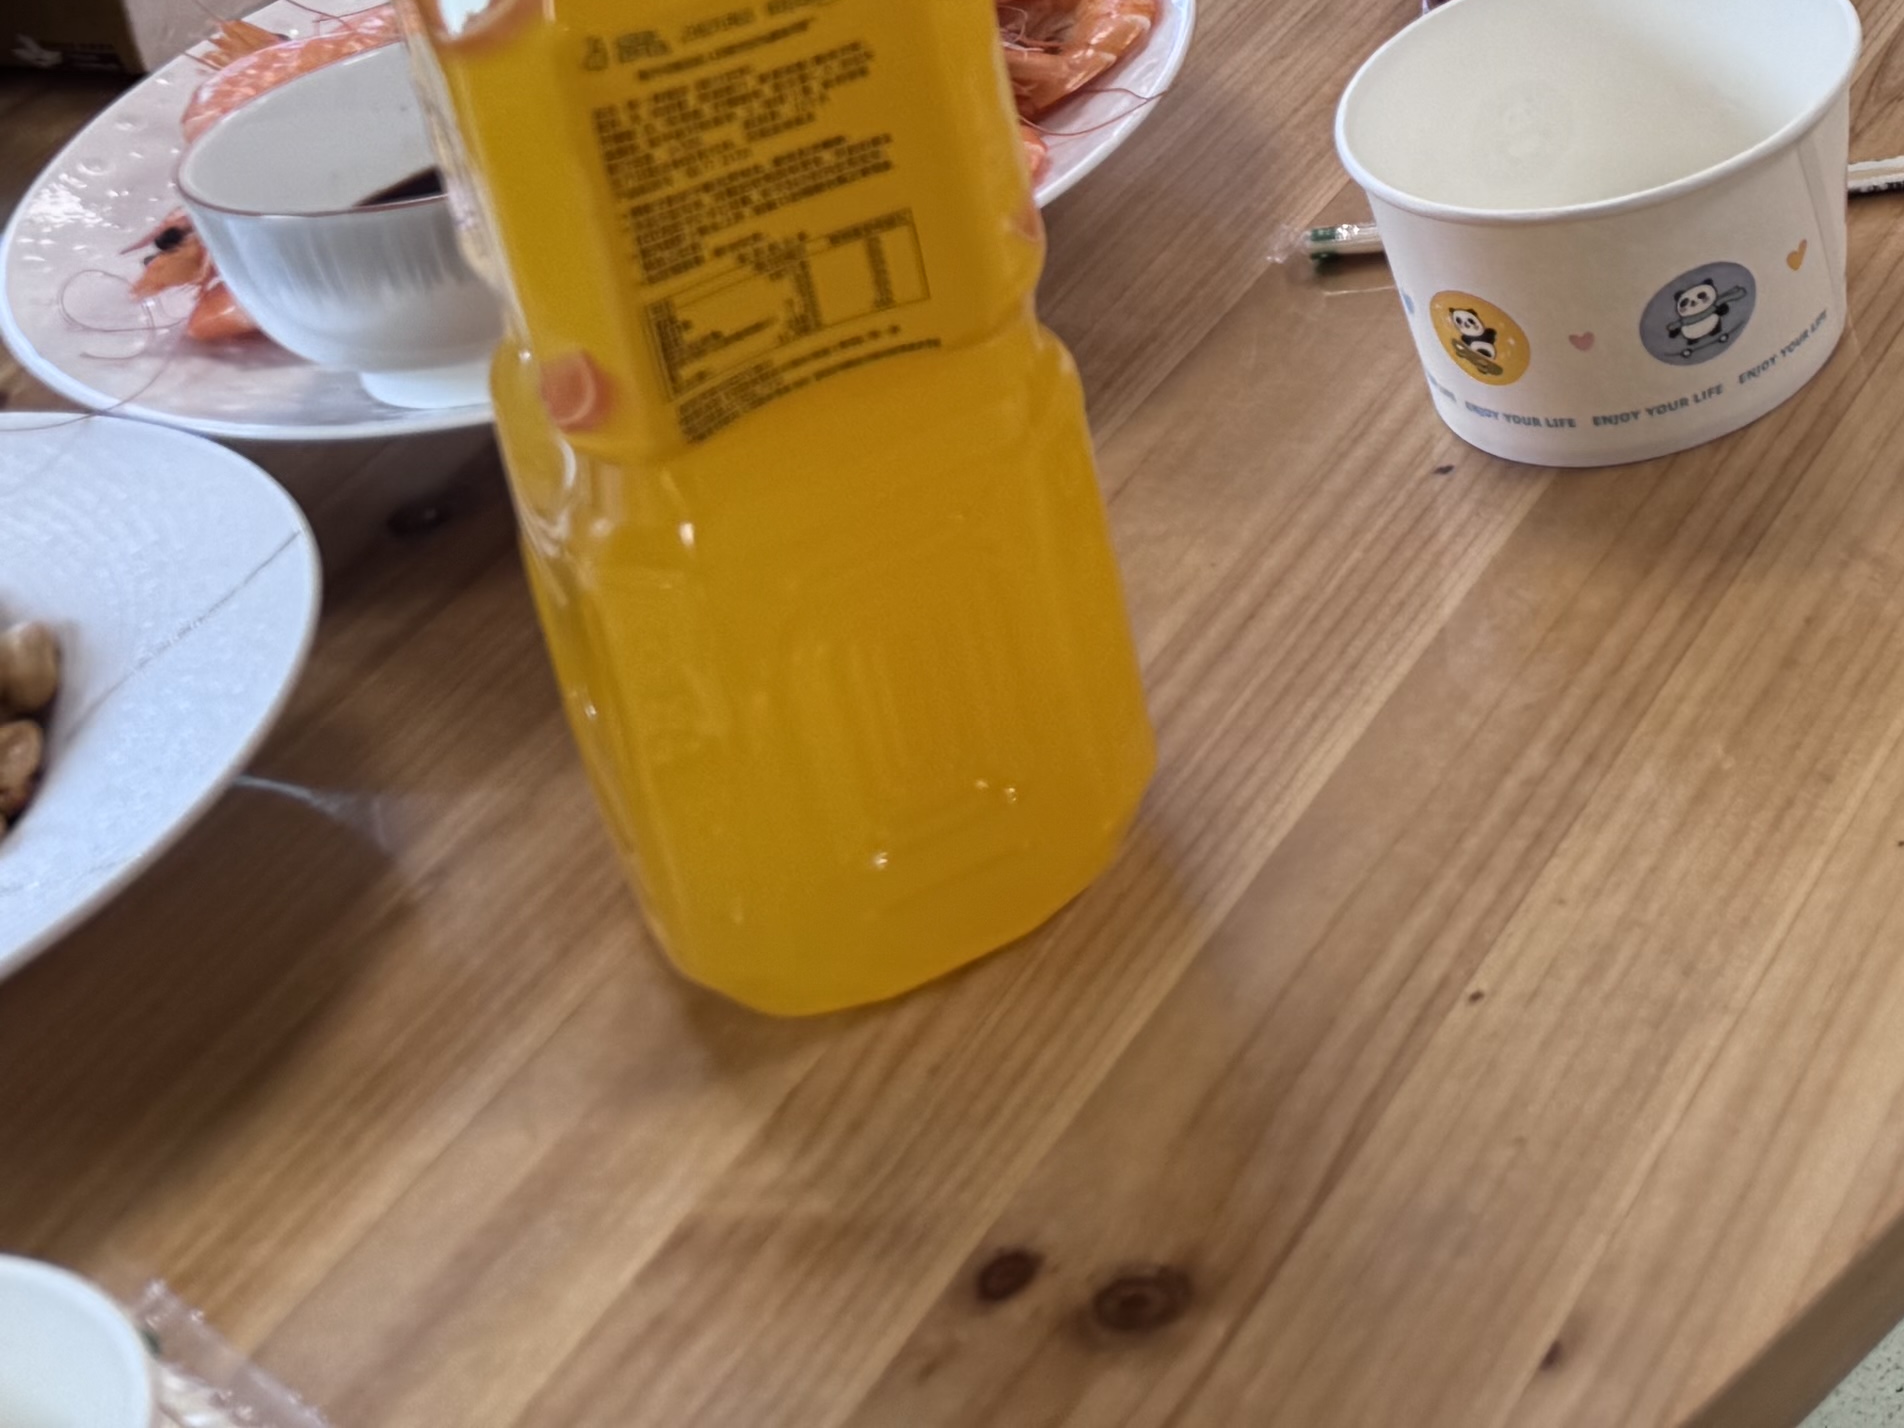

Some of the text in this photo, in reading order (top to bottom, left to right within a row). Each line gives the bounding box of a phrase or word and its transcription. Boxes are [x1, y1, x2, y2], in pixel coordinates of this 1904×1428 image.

[1738, 310, 1829, 384] ENJOY YOUR LIFE
[1465, 400, 1577, 428] ENJOY YOUR LIFE
[1592, 383, 1725, 427] ENJOY YOUR LIFE
